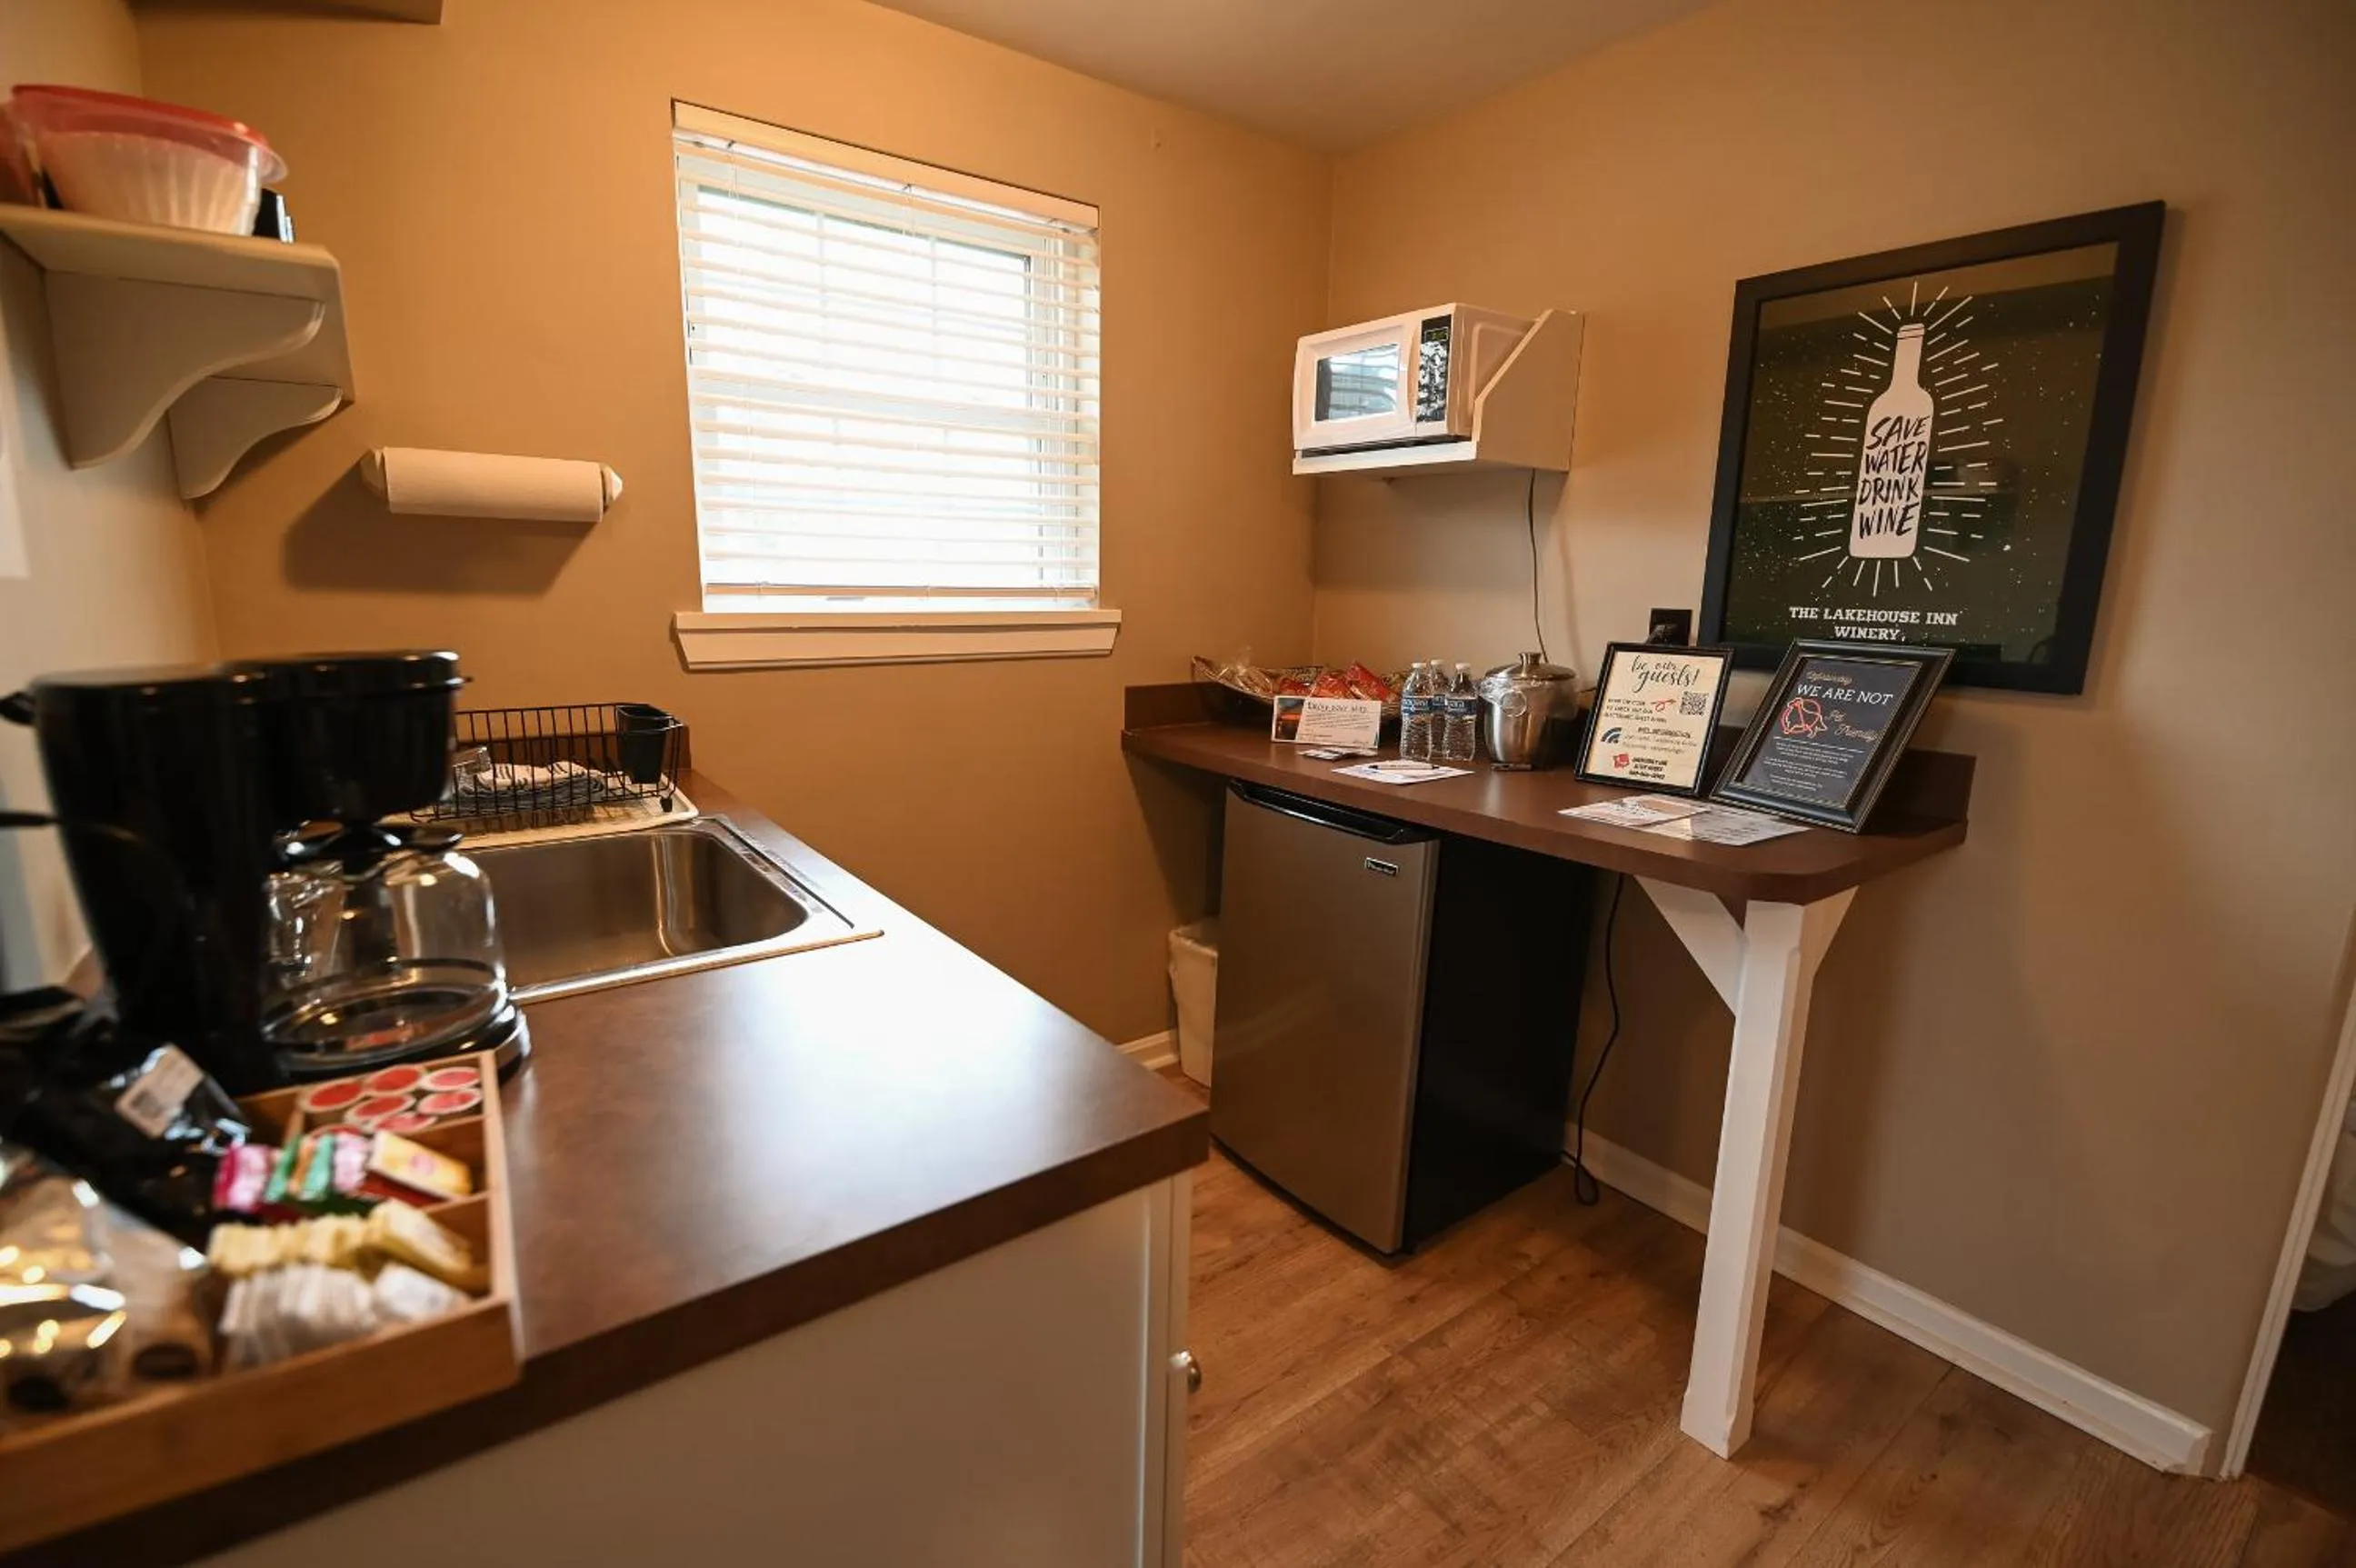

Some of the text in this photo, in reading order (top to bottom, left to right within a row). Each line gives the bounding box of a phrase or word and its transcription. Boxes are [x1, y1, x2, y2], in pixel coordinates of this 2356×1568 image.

[1866, 415, 1930, 450] SAVE
[1866, 441, 1927, 474] WATER
[1858, 474, 1921, 505] DRINK
[1859, 502, 1920, 539] WINE
[1789, 606, 1959, 626] THE LAKEHOUSE INN
[1797, 684, 1894, 705] WE ARE NOT
